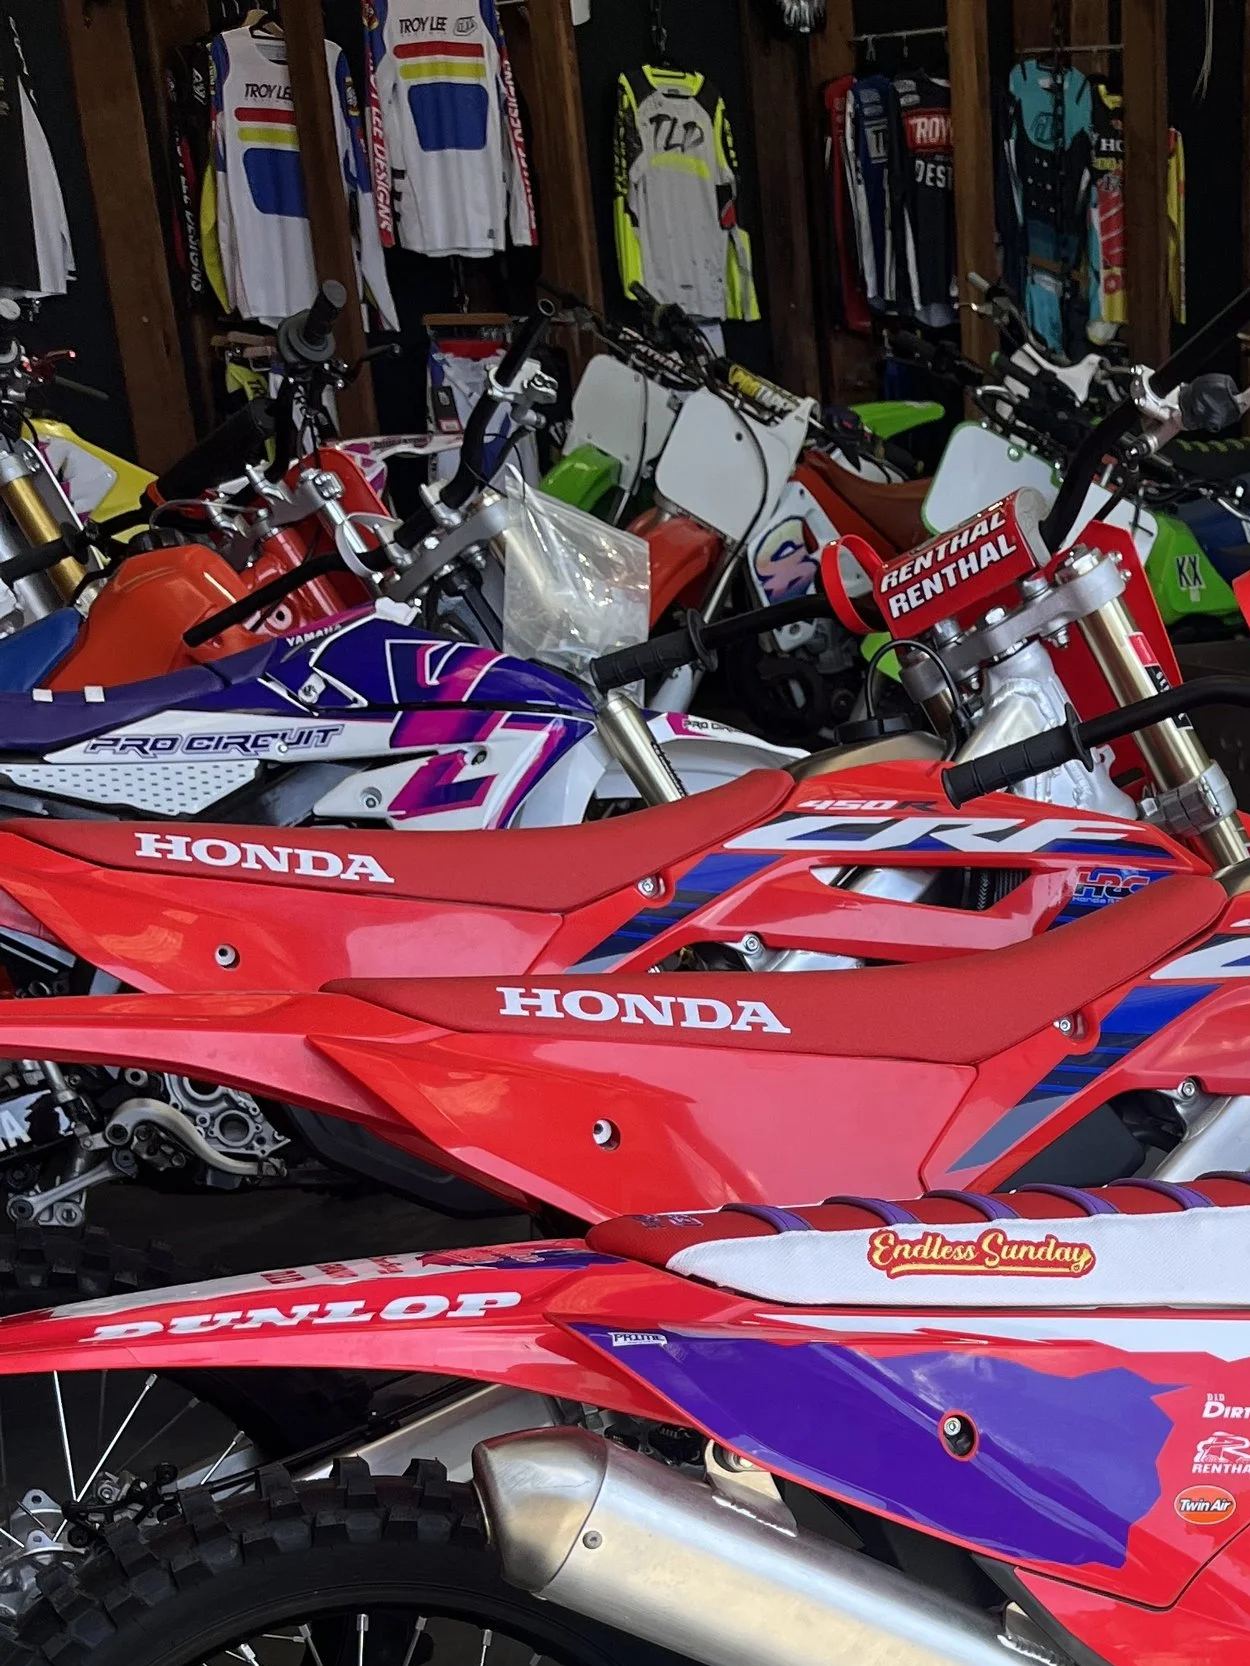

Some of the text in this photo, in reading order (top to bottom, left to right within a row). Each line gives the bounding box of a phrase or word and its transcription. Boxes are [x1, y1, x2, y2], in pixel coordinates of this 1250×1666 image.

[399, 17, 448, 34] TROY LEE
[244, 83, 294, 101] TROY LE
[374, 143, 392, 232] DESIGNS
[880, 508, 1009, 593] RENTHAL
[888, 533, 1018, 619] RENTHAL
[1176, 555, 1205, 588] KX
[286, 624, 342, 646] YAMAHA
[88, 725, 345, 755] PRO CIRCUIT
[797, 800, 940, 813] 450R
[723, 816, 1138, 853] CRF
[134, 832, 395, 884] HONDA
[496, 985, 791, 1036] HONDA
[871, 1230, 1094, 1274] Endless Sunday
[79, 1290, 522, 1343] DUNLOP
[1179, 1499, 1232, 1512] Twin Air
